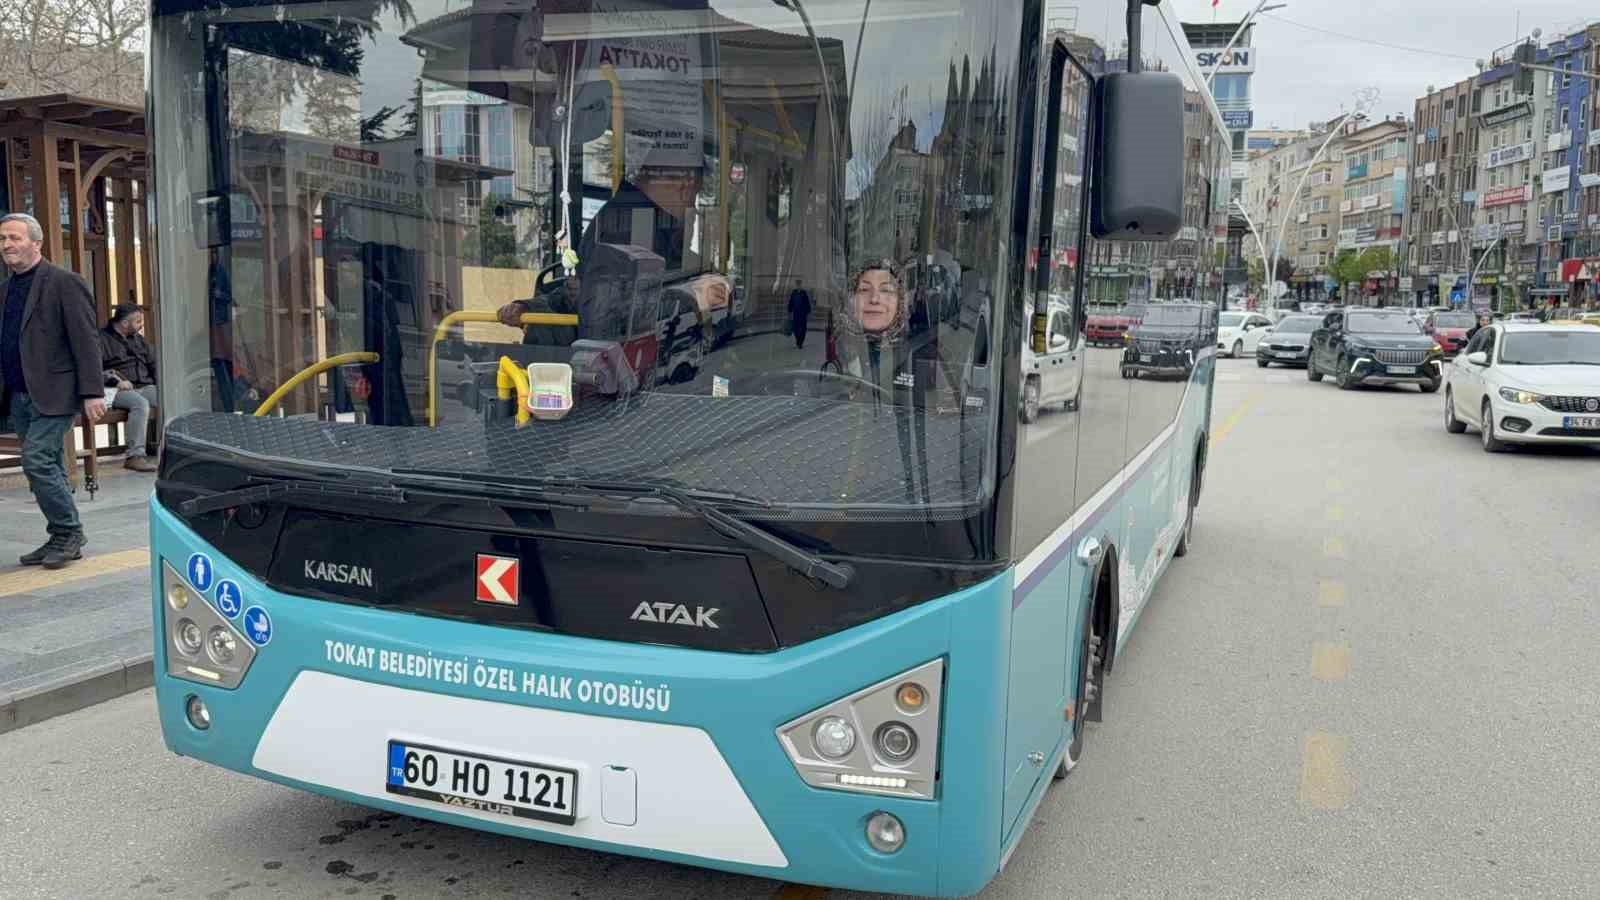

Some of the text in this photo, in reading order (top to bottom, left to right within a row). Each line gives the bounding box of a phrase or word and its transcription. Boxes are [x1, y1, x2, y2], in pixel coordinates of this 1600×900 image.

[304, 559, 373, 587] KARSAN
[630, 601, 720, 629] ATAK
[325, 639, 671, 712] TOKAT BELEDİYESİ ÖZEL HALK OTOBÜSÜ
[391, 751, 567, 810] TR 60 HO 1121
